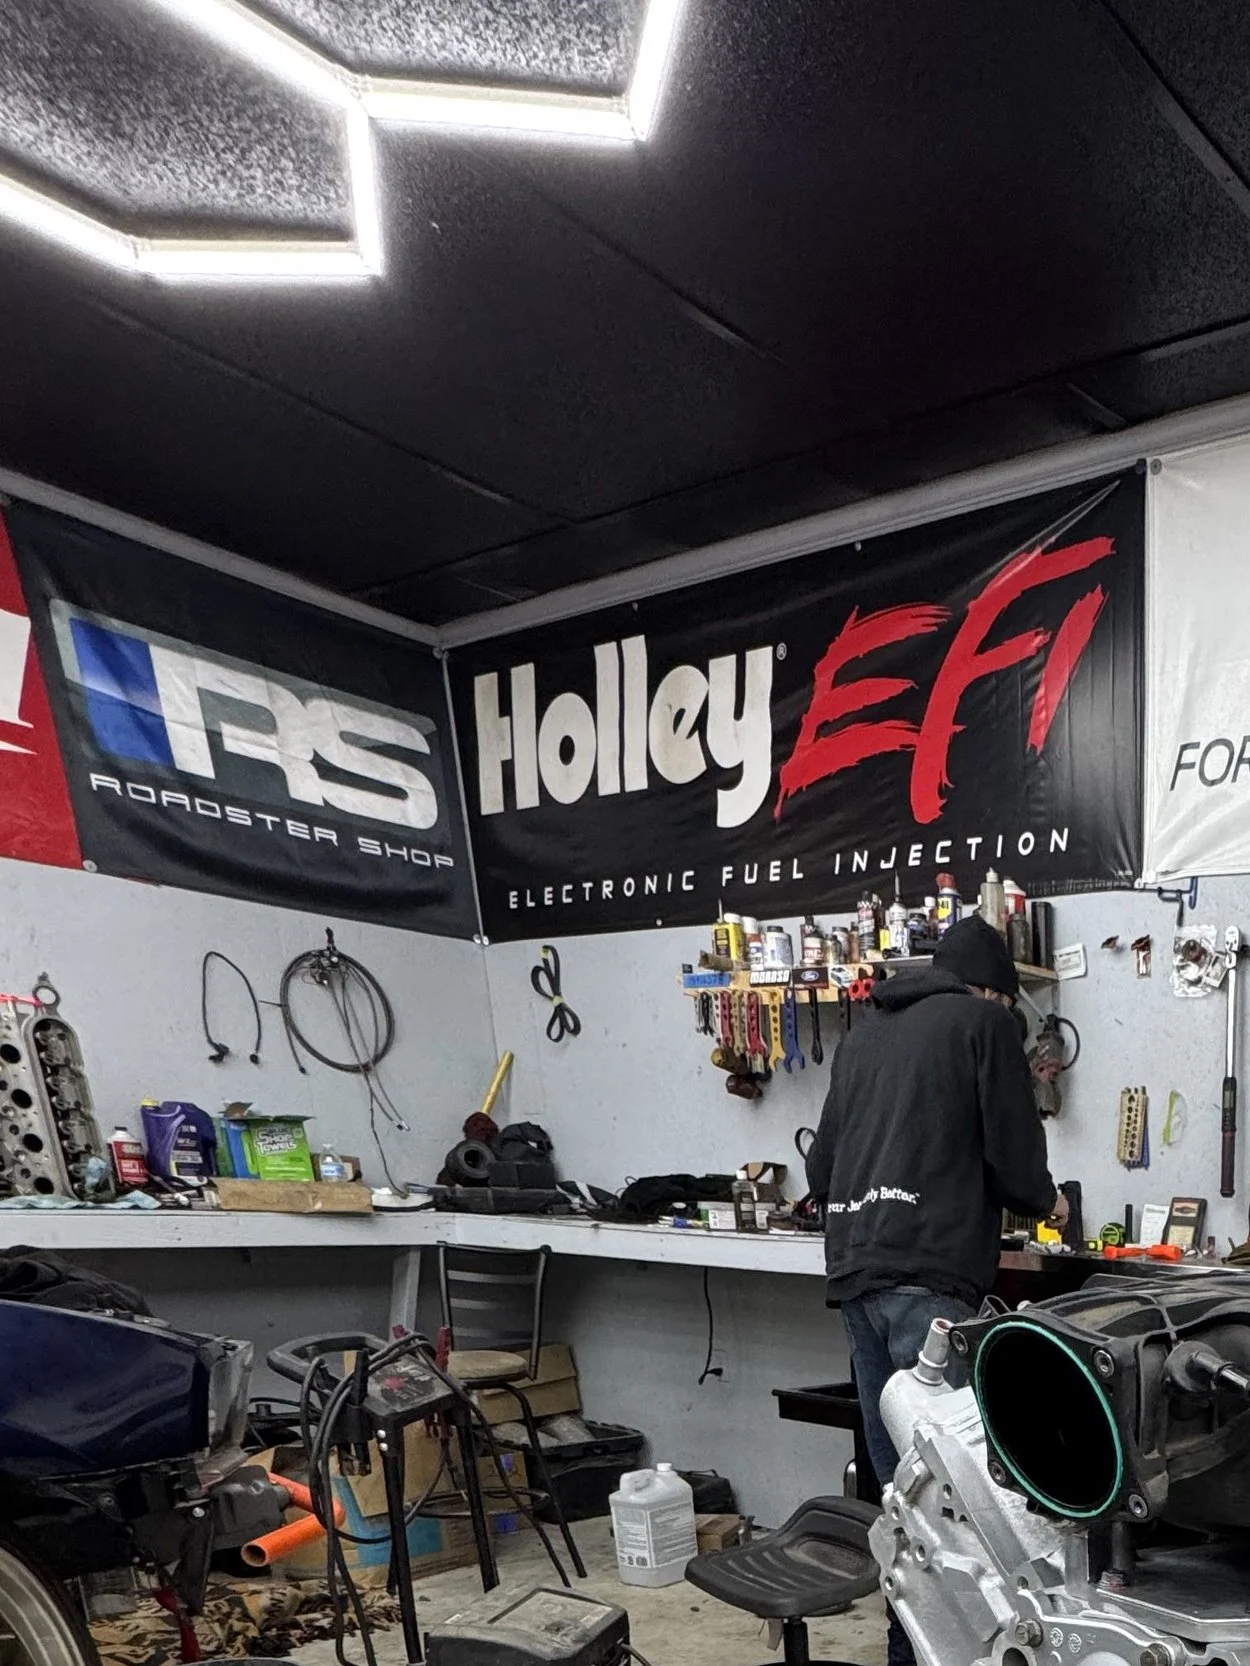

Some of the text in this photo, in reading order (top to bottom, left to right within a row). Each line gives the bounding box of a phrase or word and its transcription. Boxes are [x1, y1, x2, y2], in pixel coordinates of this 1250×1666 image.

[474, 634, 774, 828] Holley
[774, 537, 1116, 824] EFI
[89, 772, 454, 868] ROADSTER SHOP
[509, 828, 1070, 909] ELECTRONIC FUEL INJECTION
